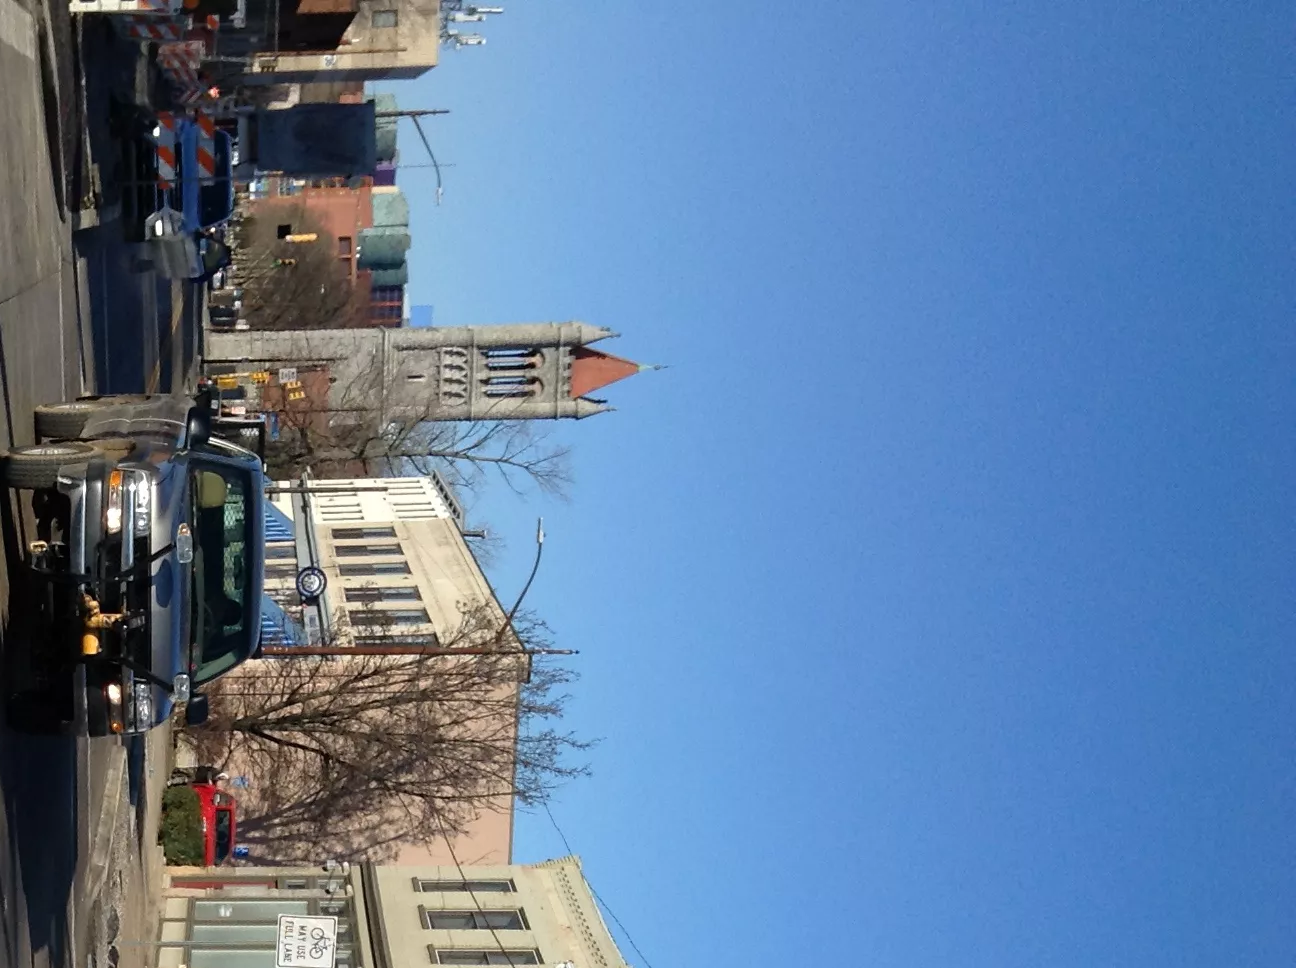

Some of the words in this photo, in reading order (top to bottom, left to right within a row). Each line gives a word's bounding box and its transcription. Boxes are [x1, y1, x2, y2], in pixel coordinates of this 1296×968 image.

[284, 920, 295, 940] FULL
[297, 925, 307, 942] MAY
[283, 943, 293, 963] LANE
[296, 945, 306, 960] USE
